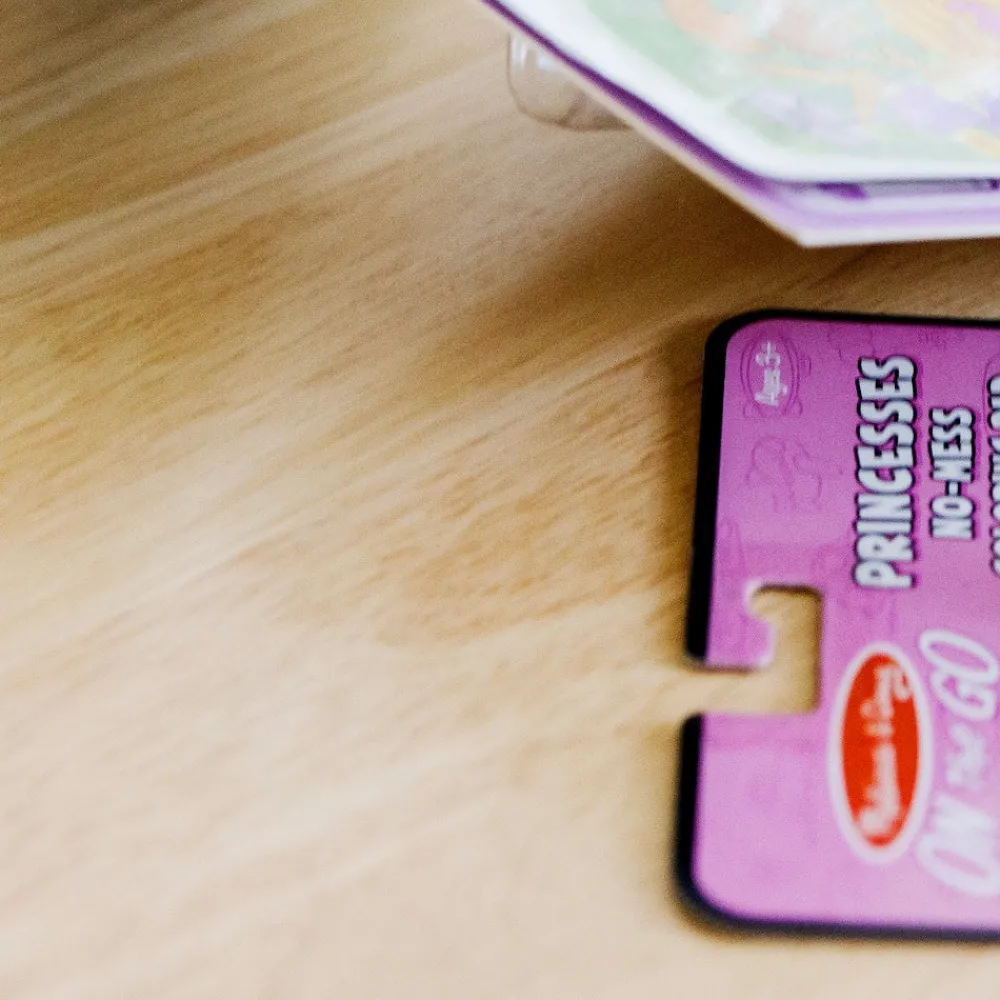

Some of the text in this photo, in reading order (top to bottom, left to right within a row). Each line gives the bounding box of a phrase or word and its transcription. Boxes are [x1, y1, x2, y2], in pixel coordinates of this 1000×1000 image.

[853, 354, 917, 590] PRINCESSES
[929, 405, 976, 541] NO-MESS
[919, 629, 1000, 721] GO
